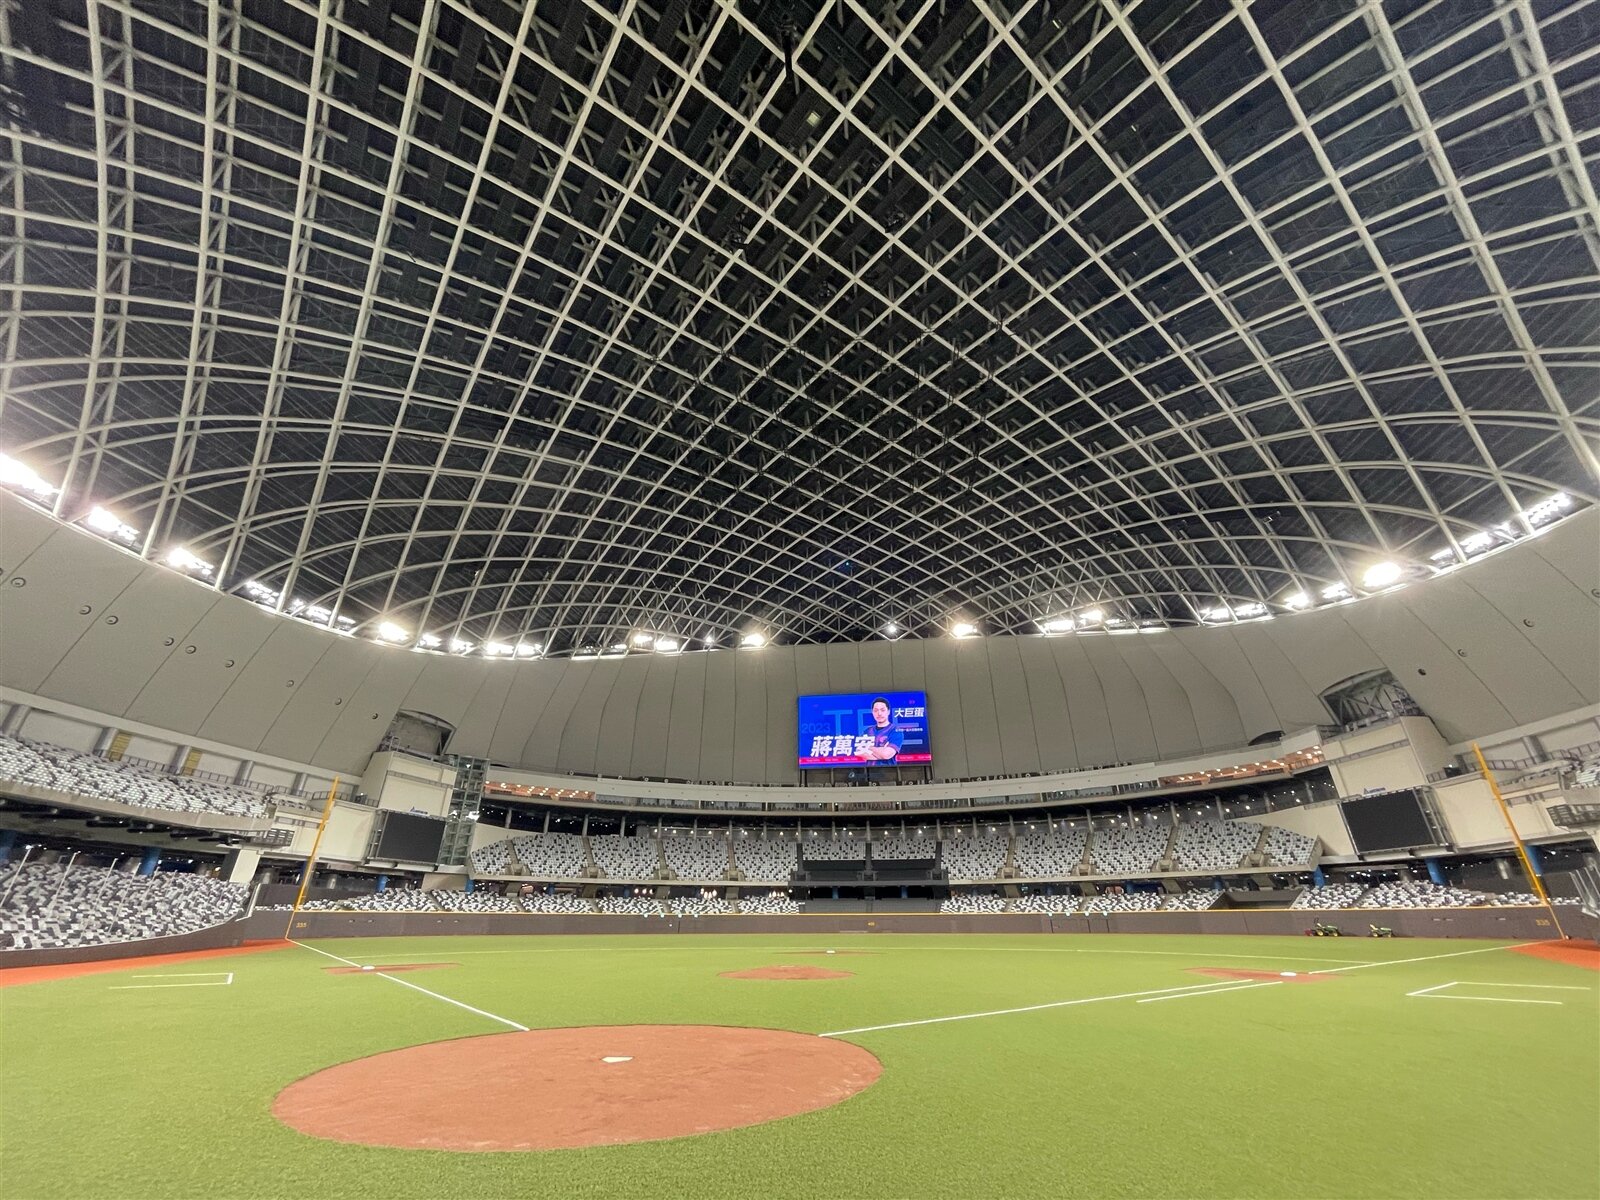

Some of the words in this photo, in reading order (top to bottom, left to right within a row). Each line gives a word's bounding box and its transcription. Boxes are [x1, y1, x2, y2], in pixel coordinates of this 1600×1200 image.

[894, 707, 924, 718] 大巨蛋
[801, 723, 831, 734] 2023
[810, 734, 876, 757] 蔣萬安
